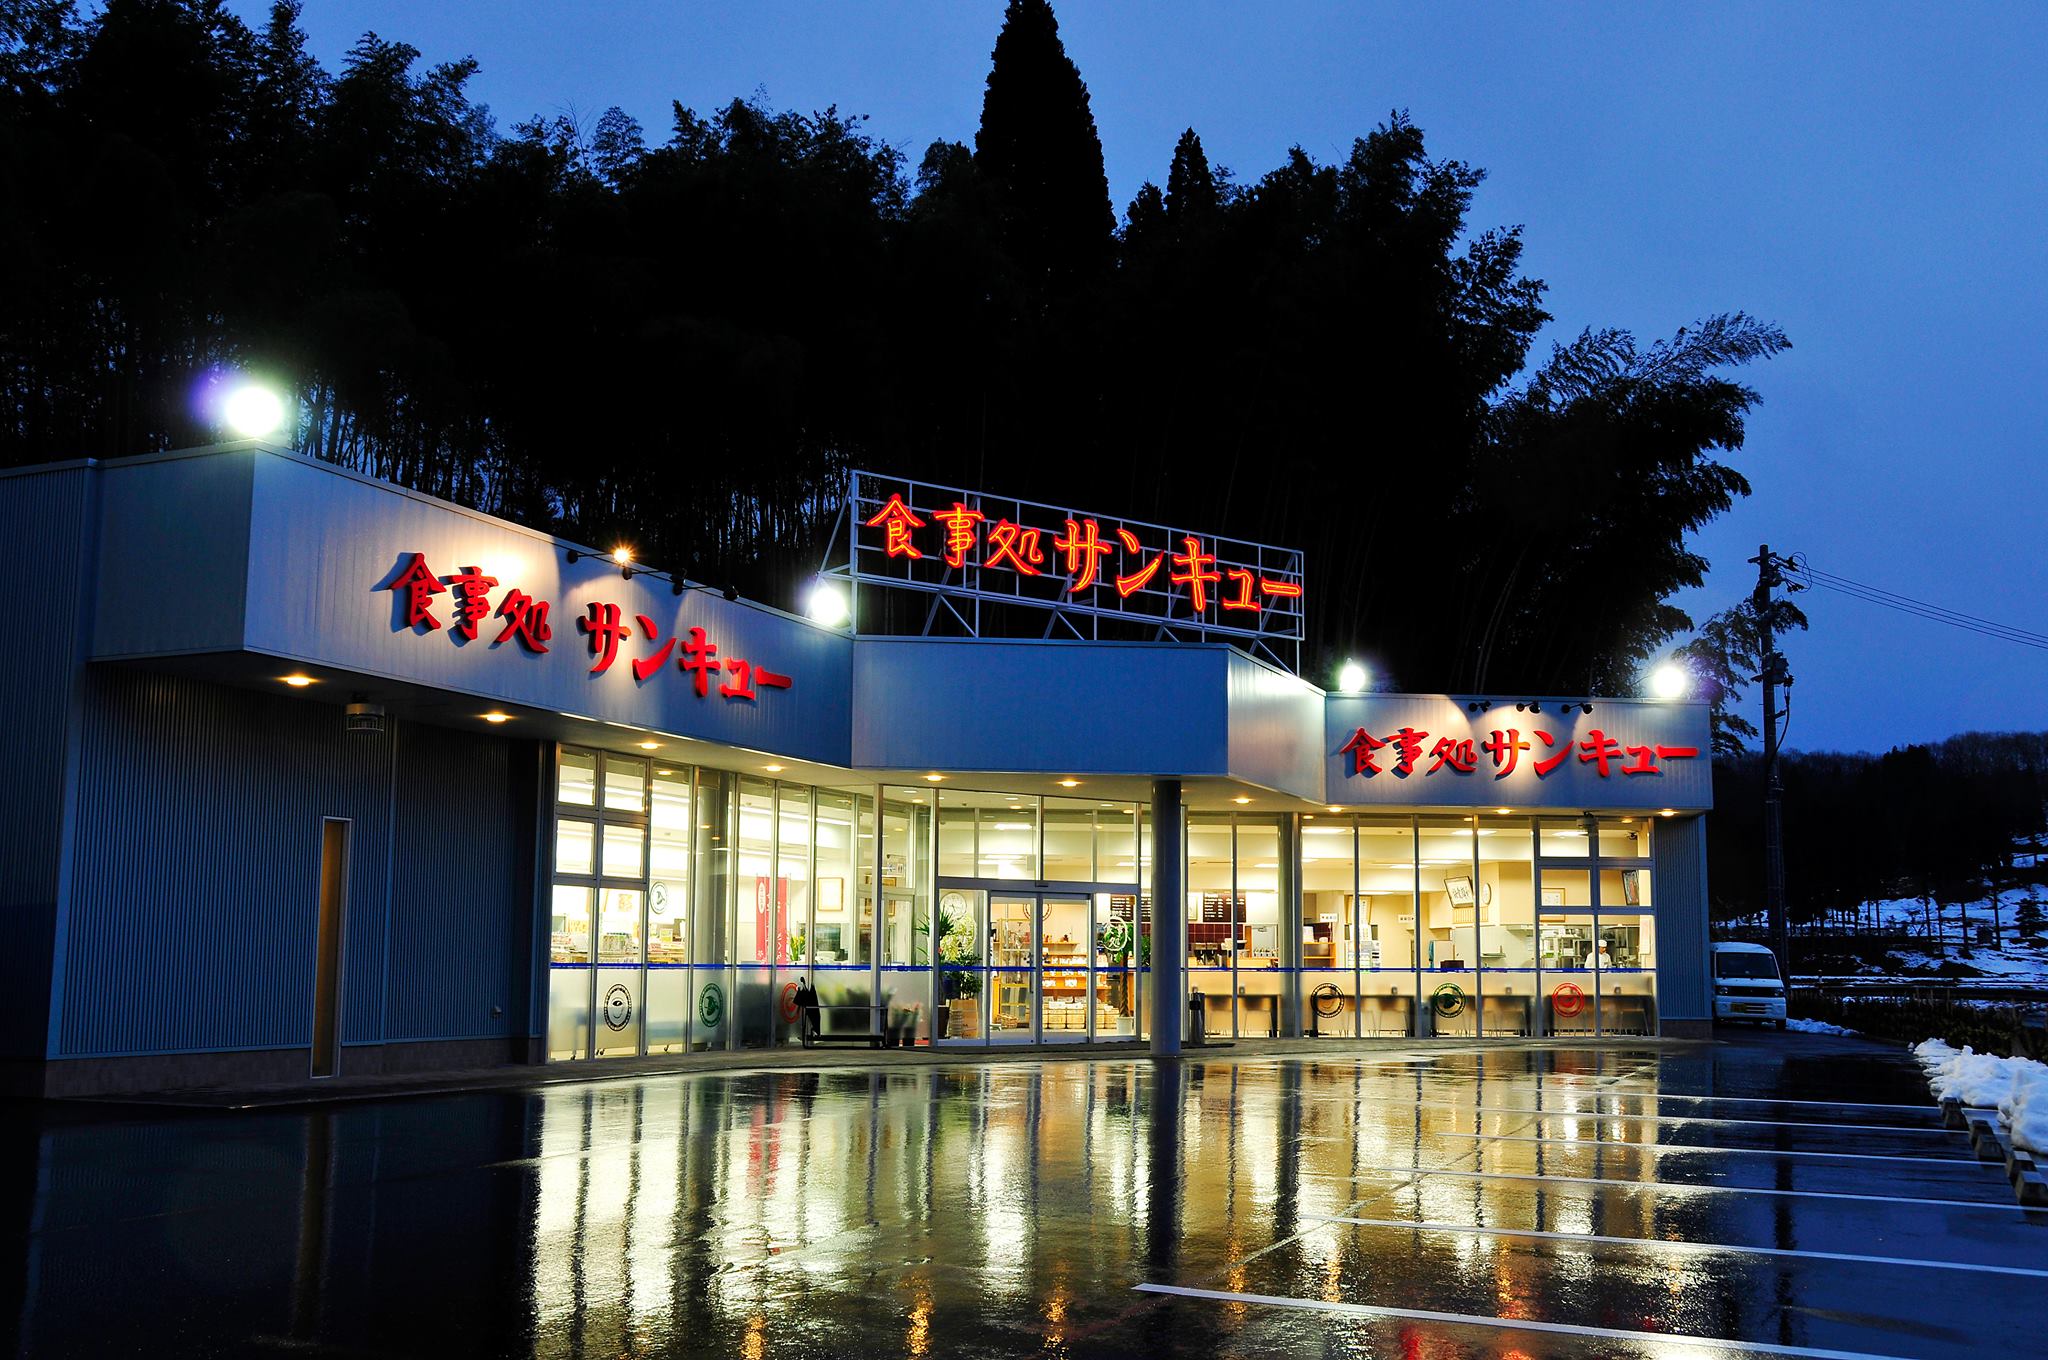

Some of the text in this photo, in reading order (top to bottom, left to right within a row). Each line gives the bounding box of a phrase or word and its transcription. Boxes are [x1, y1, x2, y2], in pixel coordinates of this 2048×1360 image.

[388, 551, 793, 701] 食事処 サンキュー
